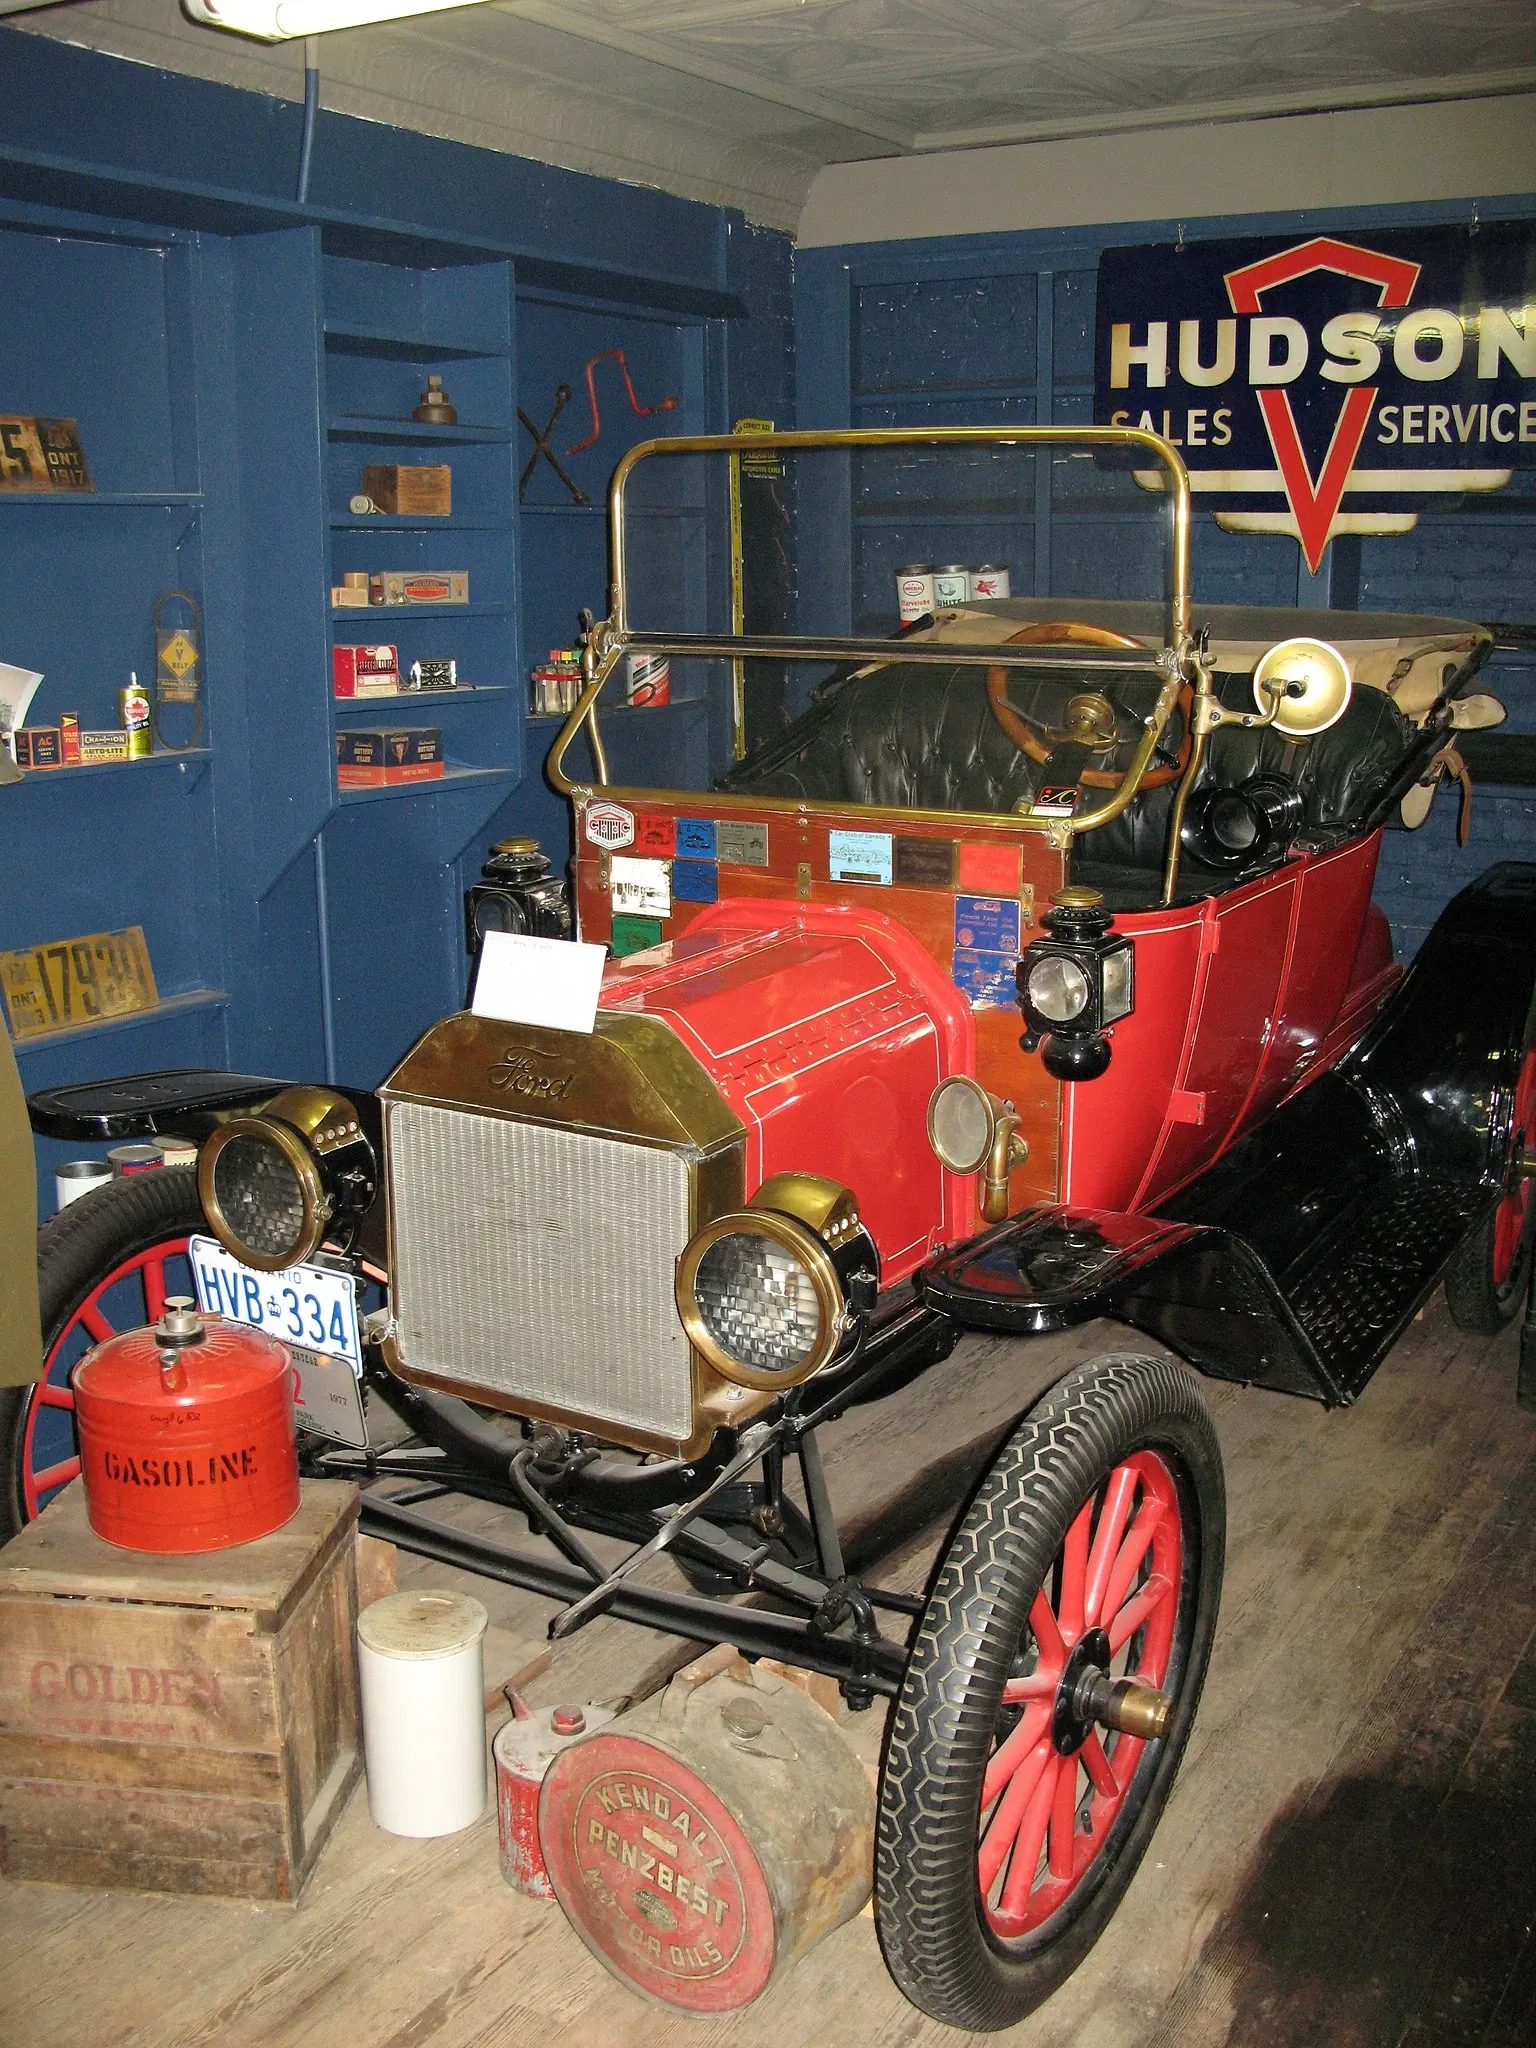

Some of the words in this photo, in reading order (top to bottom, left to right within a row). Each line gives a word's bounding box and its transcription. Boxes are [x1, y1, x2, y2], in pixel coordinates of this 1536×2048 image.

[1110, 306, 1536, 388] HUDSON
[1377, 402, 1536, 445] SERVICE
[48, 452, 79, 466] ONT
[175, 649, 184, 661] V
[38, 736, 53, 747] AC
[486, 1045, 576, 1098] Ford
[239, 1263, 302, 1285] ARIO
[200, 1264, 264, 1325] HVB
[282, 1287, 349, 1350] 334
[328, 1393, 348, 1406] 1977
[105, 1445, 258, 1487] GASOLINE
[31, 1660, 221, 1709] GOLDEN
[596, 1782, 726, 1884] KENDALL
[588, 1818, 731, 1928] PENZBEST
[669, 1940, 723, 1969] OILS
